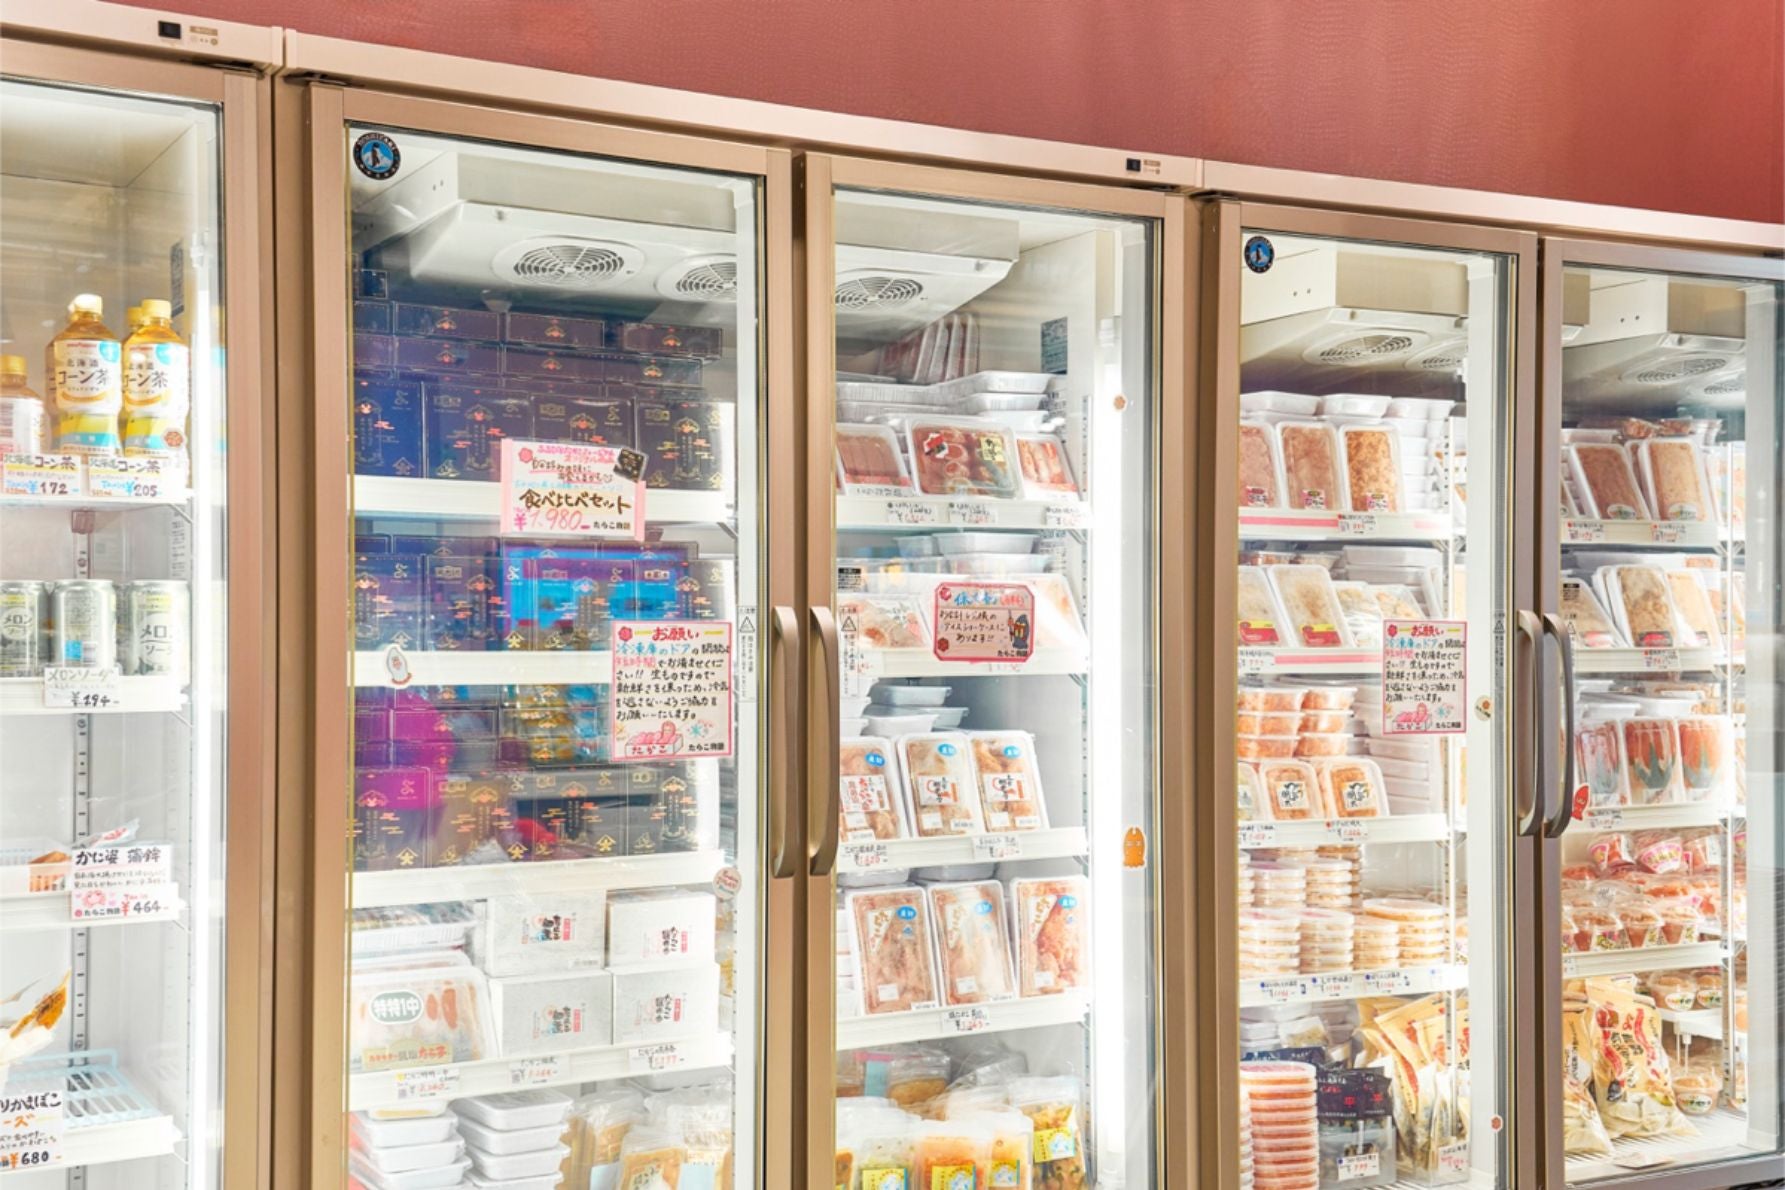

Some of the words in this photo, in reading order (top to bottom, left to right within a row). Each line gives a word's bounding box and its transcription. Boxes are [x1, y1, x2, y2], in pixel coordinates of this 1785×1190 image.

[519, 488, 632, 515] 食べ比べセット
[3, 613, 33, 625] メロン
[651, 626, 700, 641] お願い
[1411, 625, 1444, 637] お願い
[47, 668, 114, 682] メロンソーダ
[75, 849, 119, 865] かに姿
